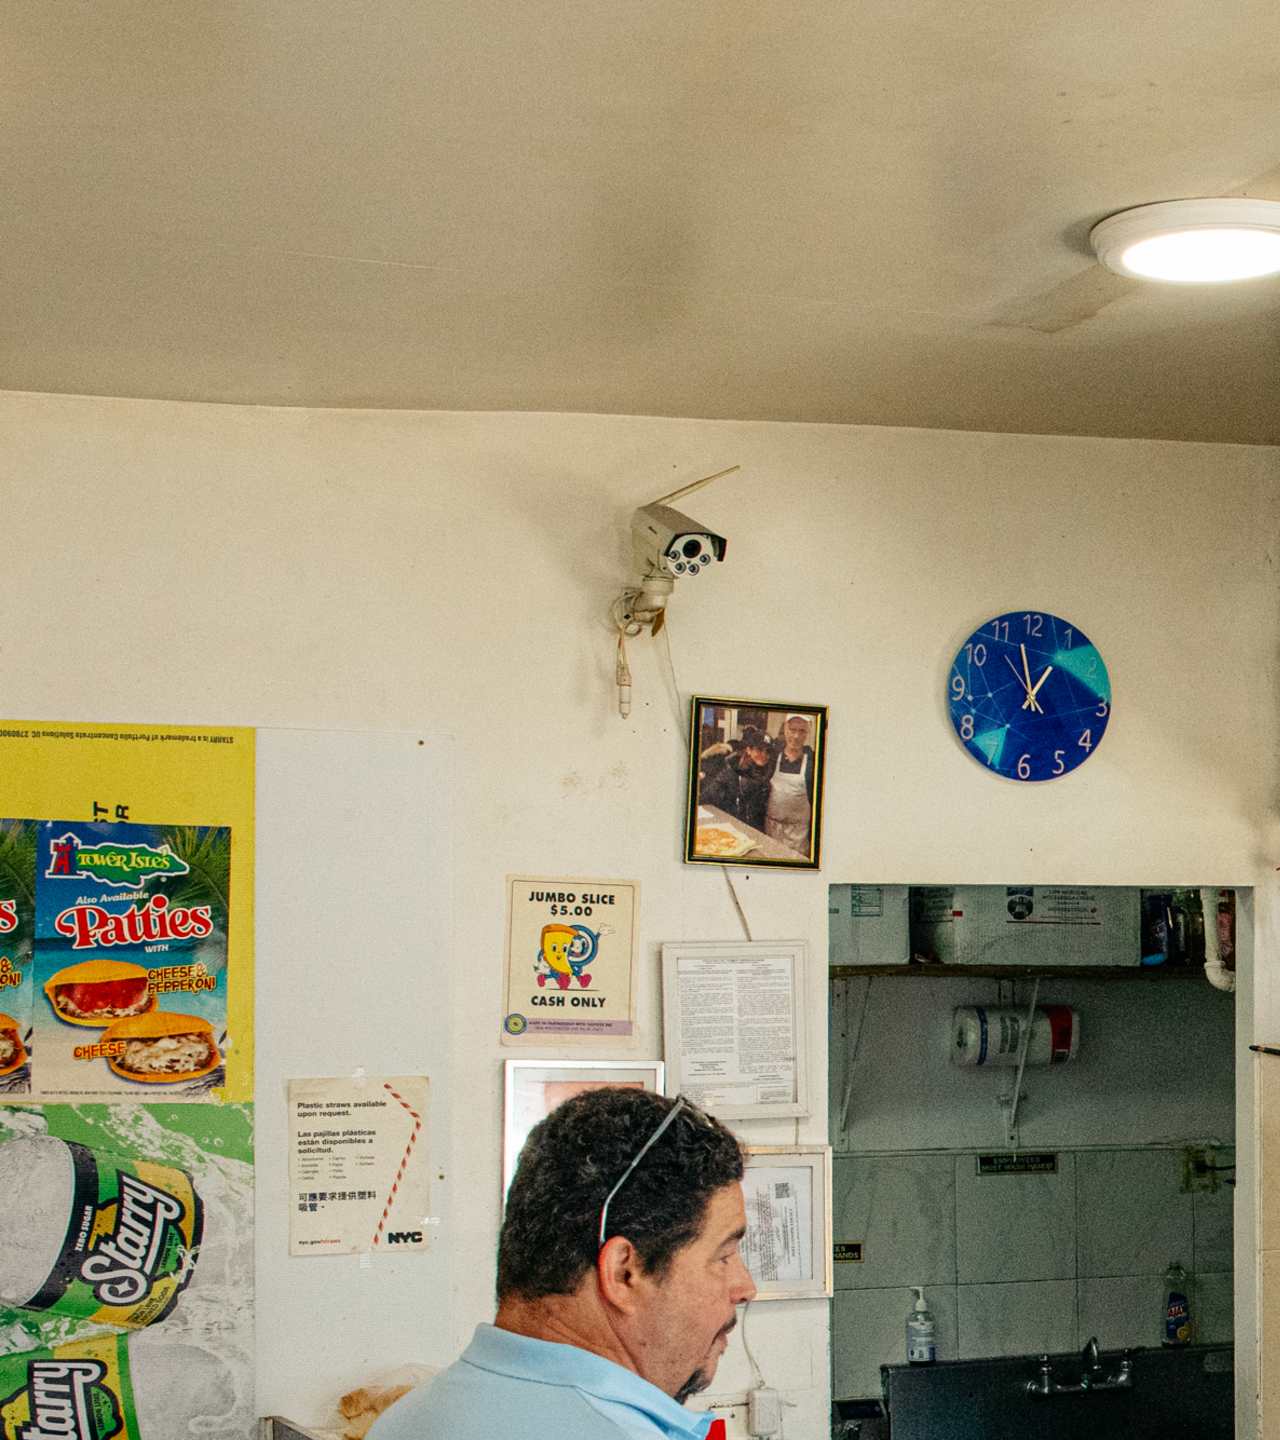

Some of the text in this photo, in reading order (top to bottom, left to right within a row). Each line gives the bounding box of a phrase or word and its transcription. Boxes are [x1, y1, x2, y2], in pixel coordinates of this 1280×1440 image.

[992, 620, 1010, 643] 11
[1023, 614, 1044, 637] 12
[1064, 629, 1073, 649] 1
[964, 643, 987, 666] 10
[952, 676, 965, 701] 9
[1095, 695, 1108, 717] 3
[960, 714, 974, 740] 8
[1078, 729, 1092, 752] 4
[987, 741, 999, 765] 7
[1052, 750, 1065, 774] 5
[1017, 754, 1031, 779] 6
[75, 891, 150, 905] Also Available
[529, 891, 615, 905] JUMBO SLICE
[55, 894, 214, 950] Patties
[550, 905, 593, 917] $5.00
[144, 944, 169, 953] WITH
[147, 963, 207, 980] CHEESE &
[147, 976, 217, 994] PEPPERONI
[531, 995, 606, 1009] CASH ONLY
[73, 1042, 126, 1059] CHEESE
[297, 1110, 352, 1119] upon request.
[353, 1100, 387, 1108] available
[75, 1205, 93, 1251] ZERO SUGAR
[387, 1231, 423, 1244] NYC
[81, 1175, 181, 1304] Starry
